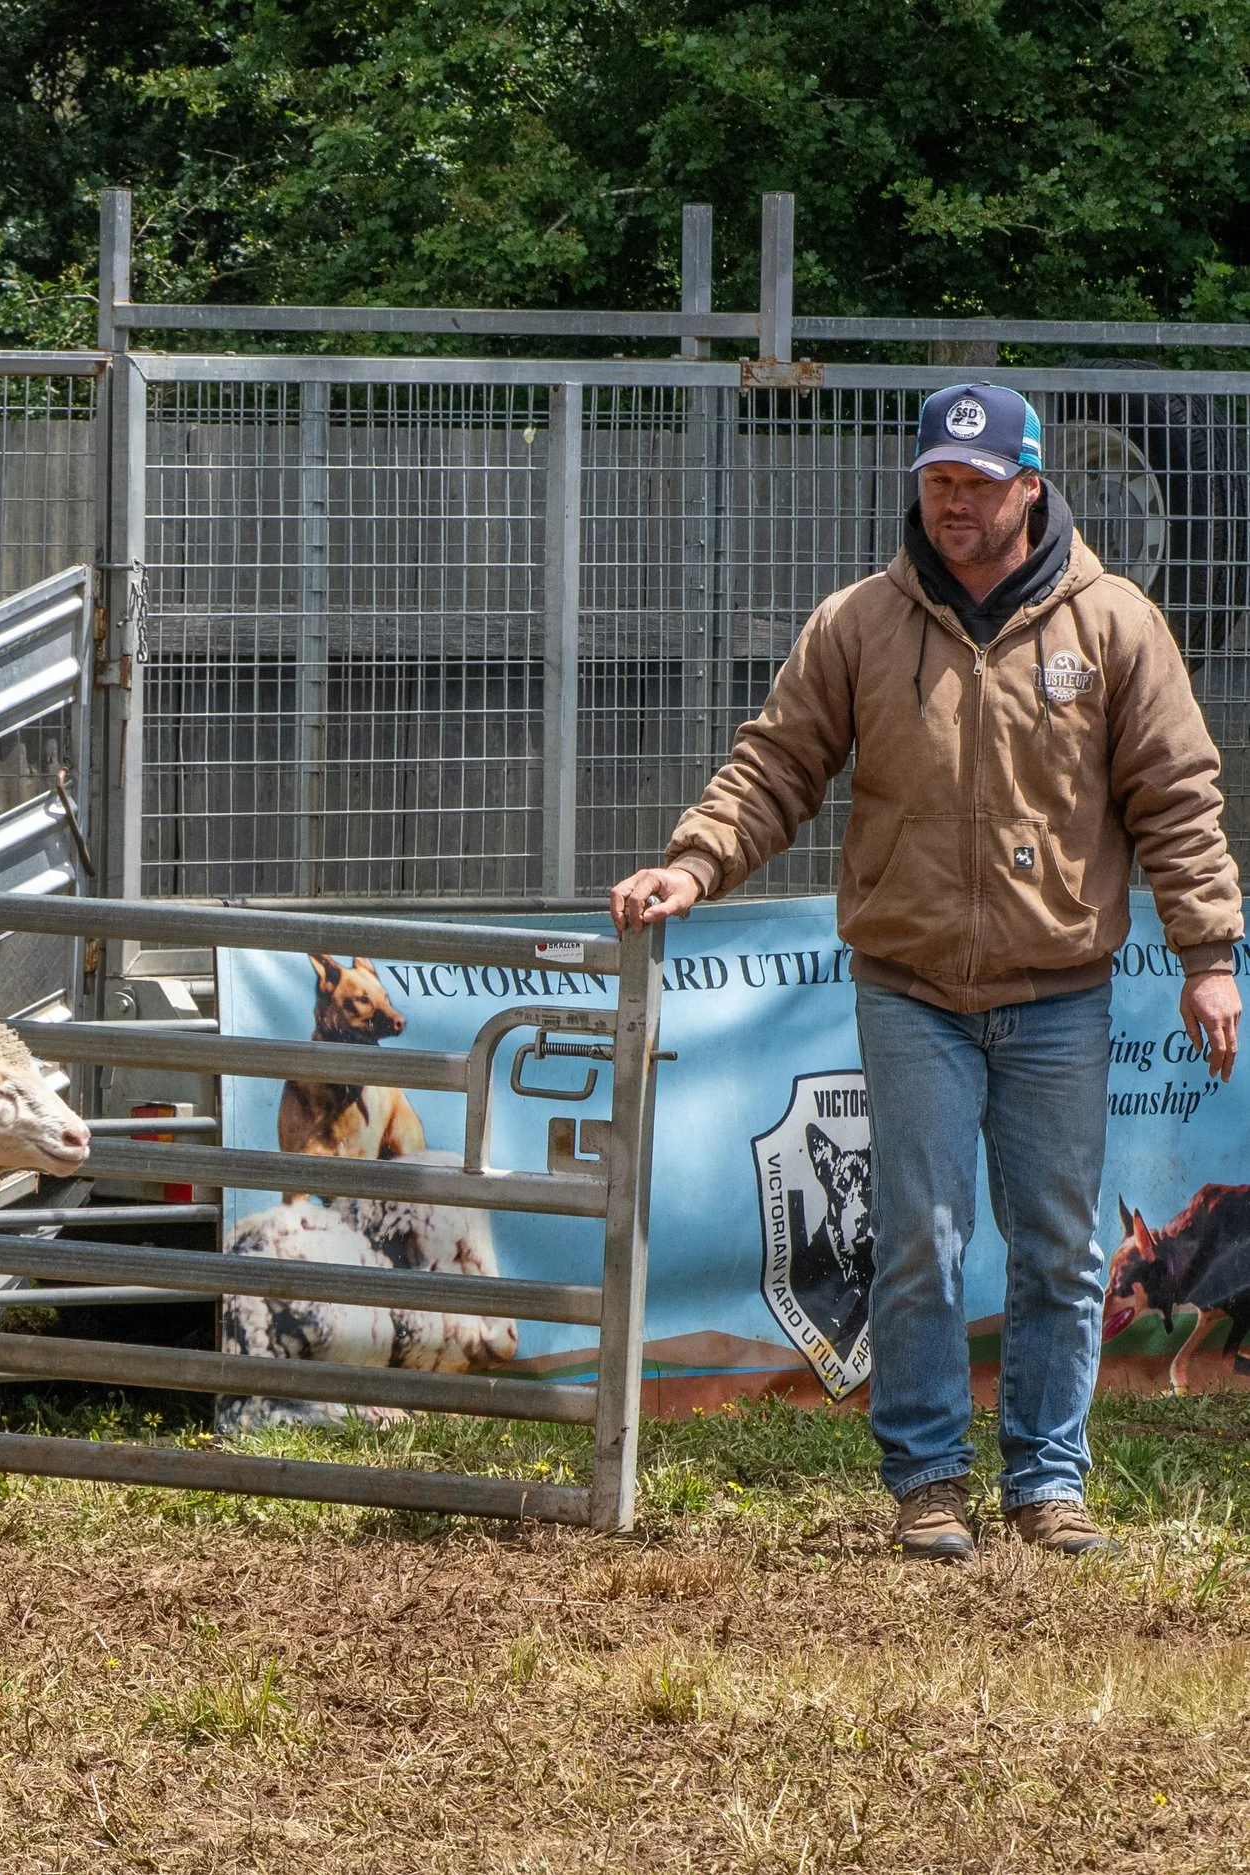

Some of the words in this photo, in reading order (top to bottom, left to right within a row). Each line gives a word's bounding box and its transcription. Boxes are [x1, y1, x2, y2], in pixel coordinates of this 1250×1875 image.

[955, 407, 978, 419] SSD
[386, 964, 608, 997] VICTORIAN
[662, 956, 728, 991] RD
[737, 949, 855, 988] UTILI
[1109, 1031, 1156, 1072] ting
[814, 1089, 868, 1118] VICTOR
[767, 1152, 788, 1271] VICTORIAN
[772, 1273, 803, 1327] YARD
[802, 1327, 849, 1390] UTILITY
[852, 1331, 869, 1374] FAR
